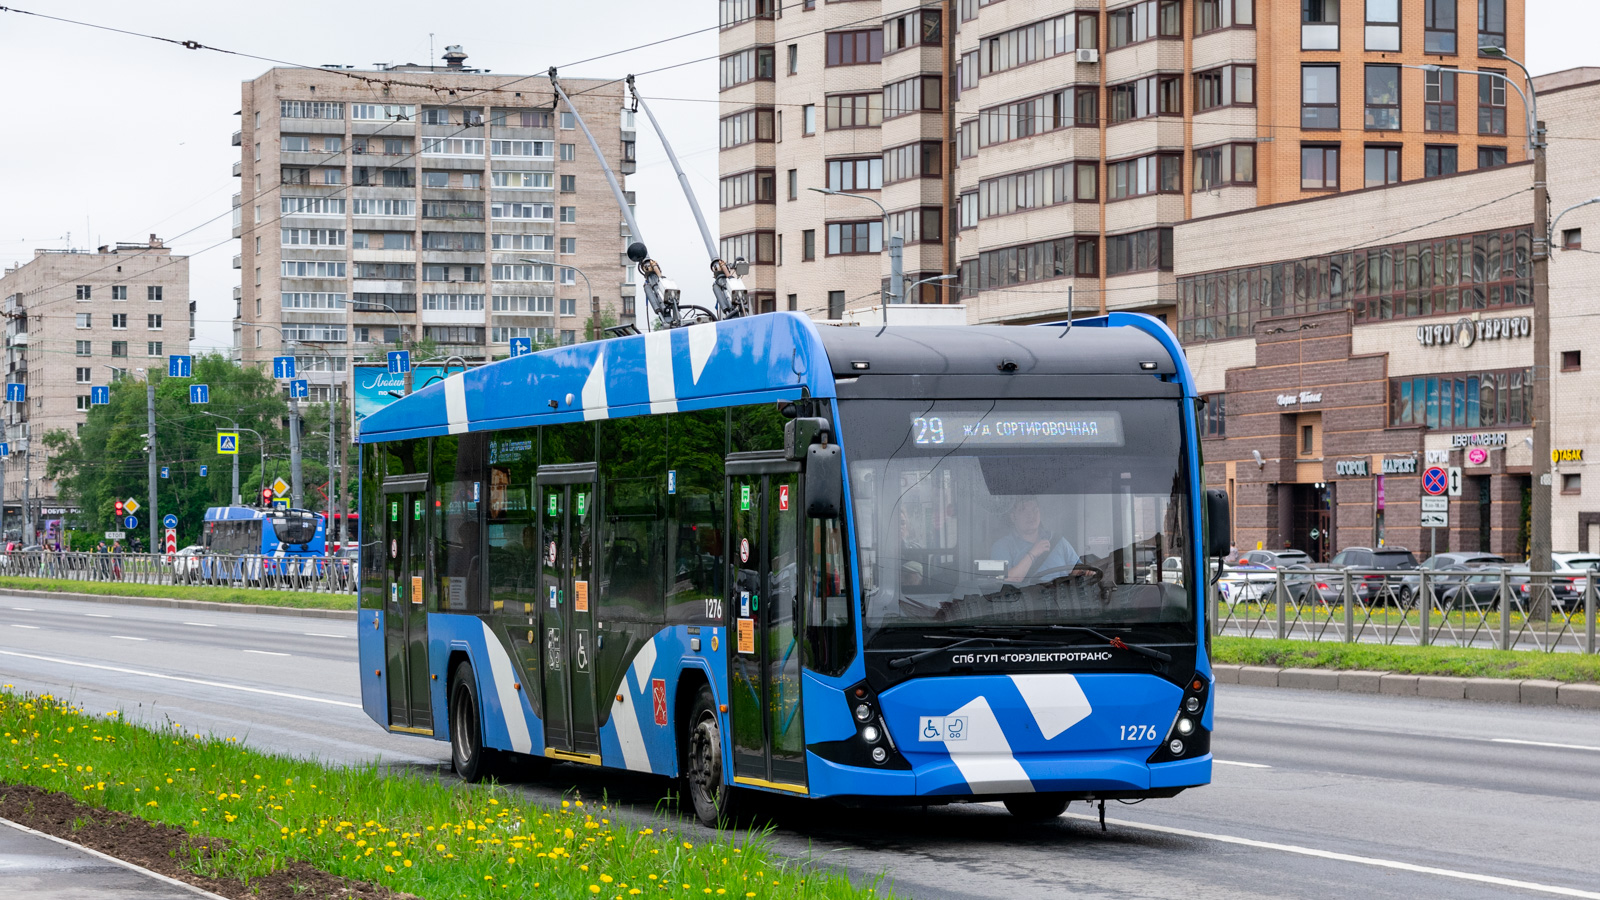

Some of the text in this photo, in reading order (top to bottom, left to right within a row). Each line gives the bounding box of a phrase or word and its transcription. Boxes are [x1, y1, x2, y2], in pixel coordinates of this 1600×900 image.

[1416, 316, 1530, 345] ЧИТО ГВРИТО
[913, 417, 1098, 444] 29 ж/д СОРТИРОВОЧНАЯ
[1558, 449, 1582, 461] ТАБАК
[1336, 458, 1416, 476] ОГОРОД МАРКЕТ
[705, 598, 722, 619] 1276
[952, 651, 1113, 664] СПб ГУП «ГОРЭЛЕКТРОТРАНС»
[1120, 724, 1157, 741] 1276
